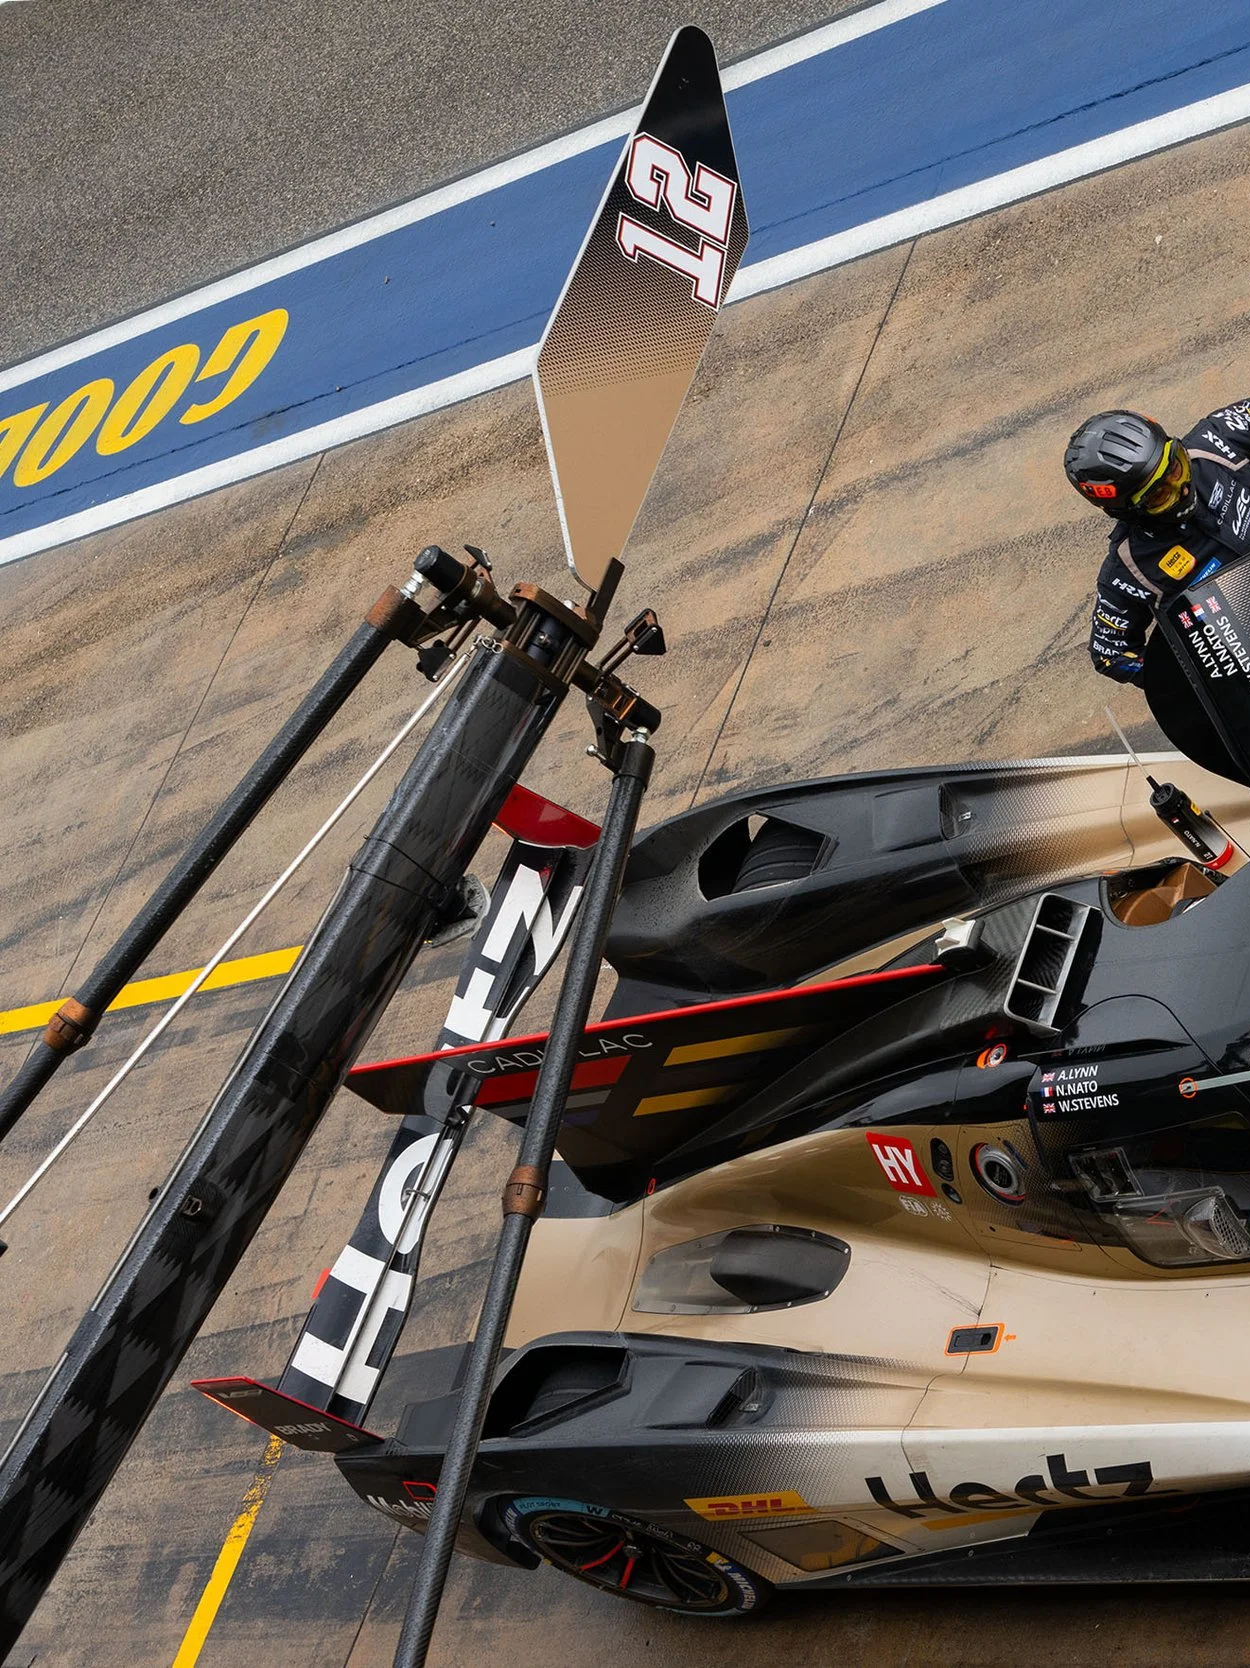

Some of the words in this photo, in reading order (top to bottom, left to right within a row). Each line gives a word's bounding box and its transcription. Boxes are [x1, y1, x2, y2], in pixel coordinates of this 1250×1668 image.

[616, 131, 738, 311] 12
[1216, 479, 1237, 526] CADILLAC
[1112, 578, 1151, 600] HRX
[1188, 630, 1223, 678] A.LYNN
[1203, 624, 1238, 676] N.NATO
[467, 1034, 653, 1074] CADLAC
[1058, 1065, 1098, 1081] A.LYNN
[1056, 1080, 1098, 1097] N.NATO
[1058, 1094, 1119, 1113] W.STEVENS
[291, 864, 585, 1405] Hetz
[872, 1143, 923, 1186] HY
[274, 1422, 331, 1436] BRADY
[864, 1453, 1183, 1519] Hertz
[586, 1504, 604, 1515] W
[708, 1498, 796, 1517] DHL
